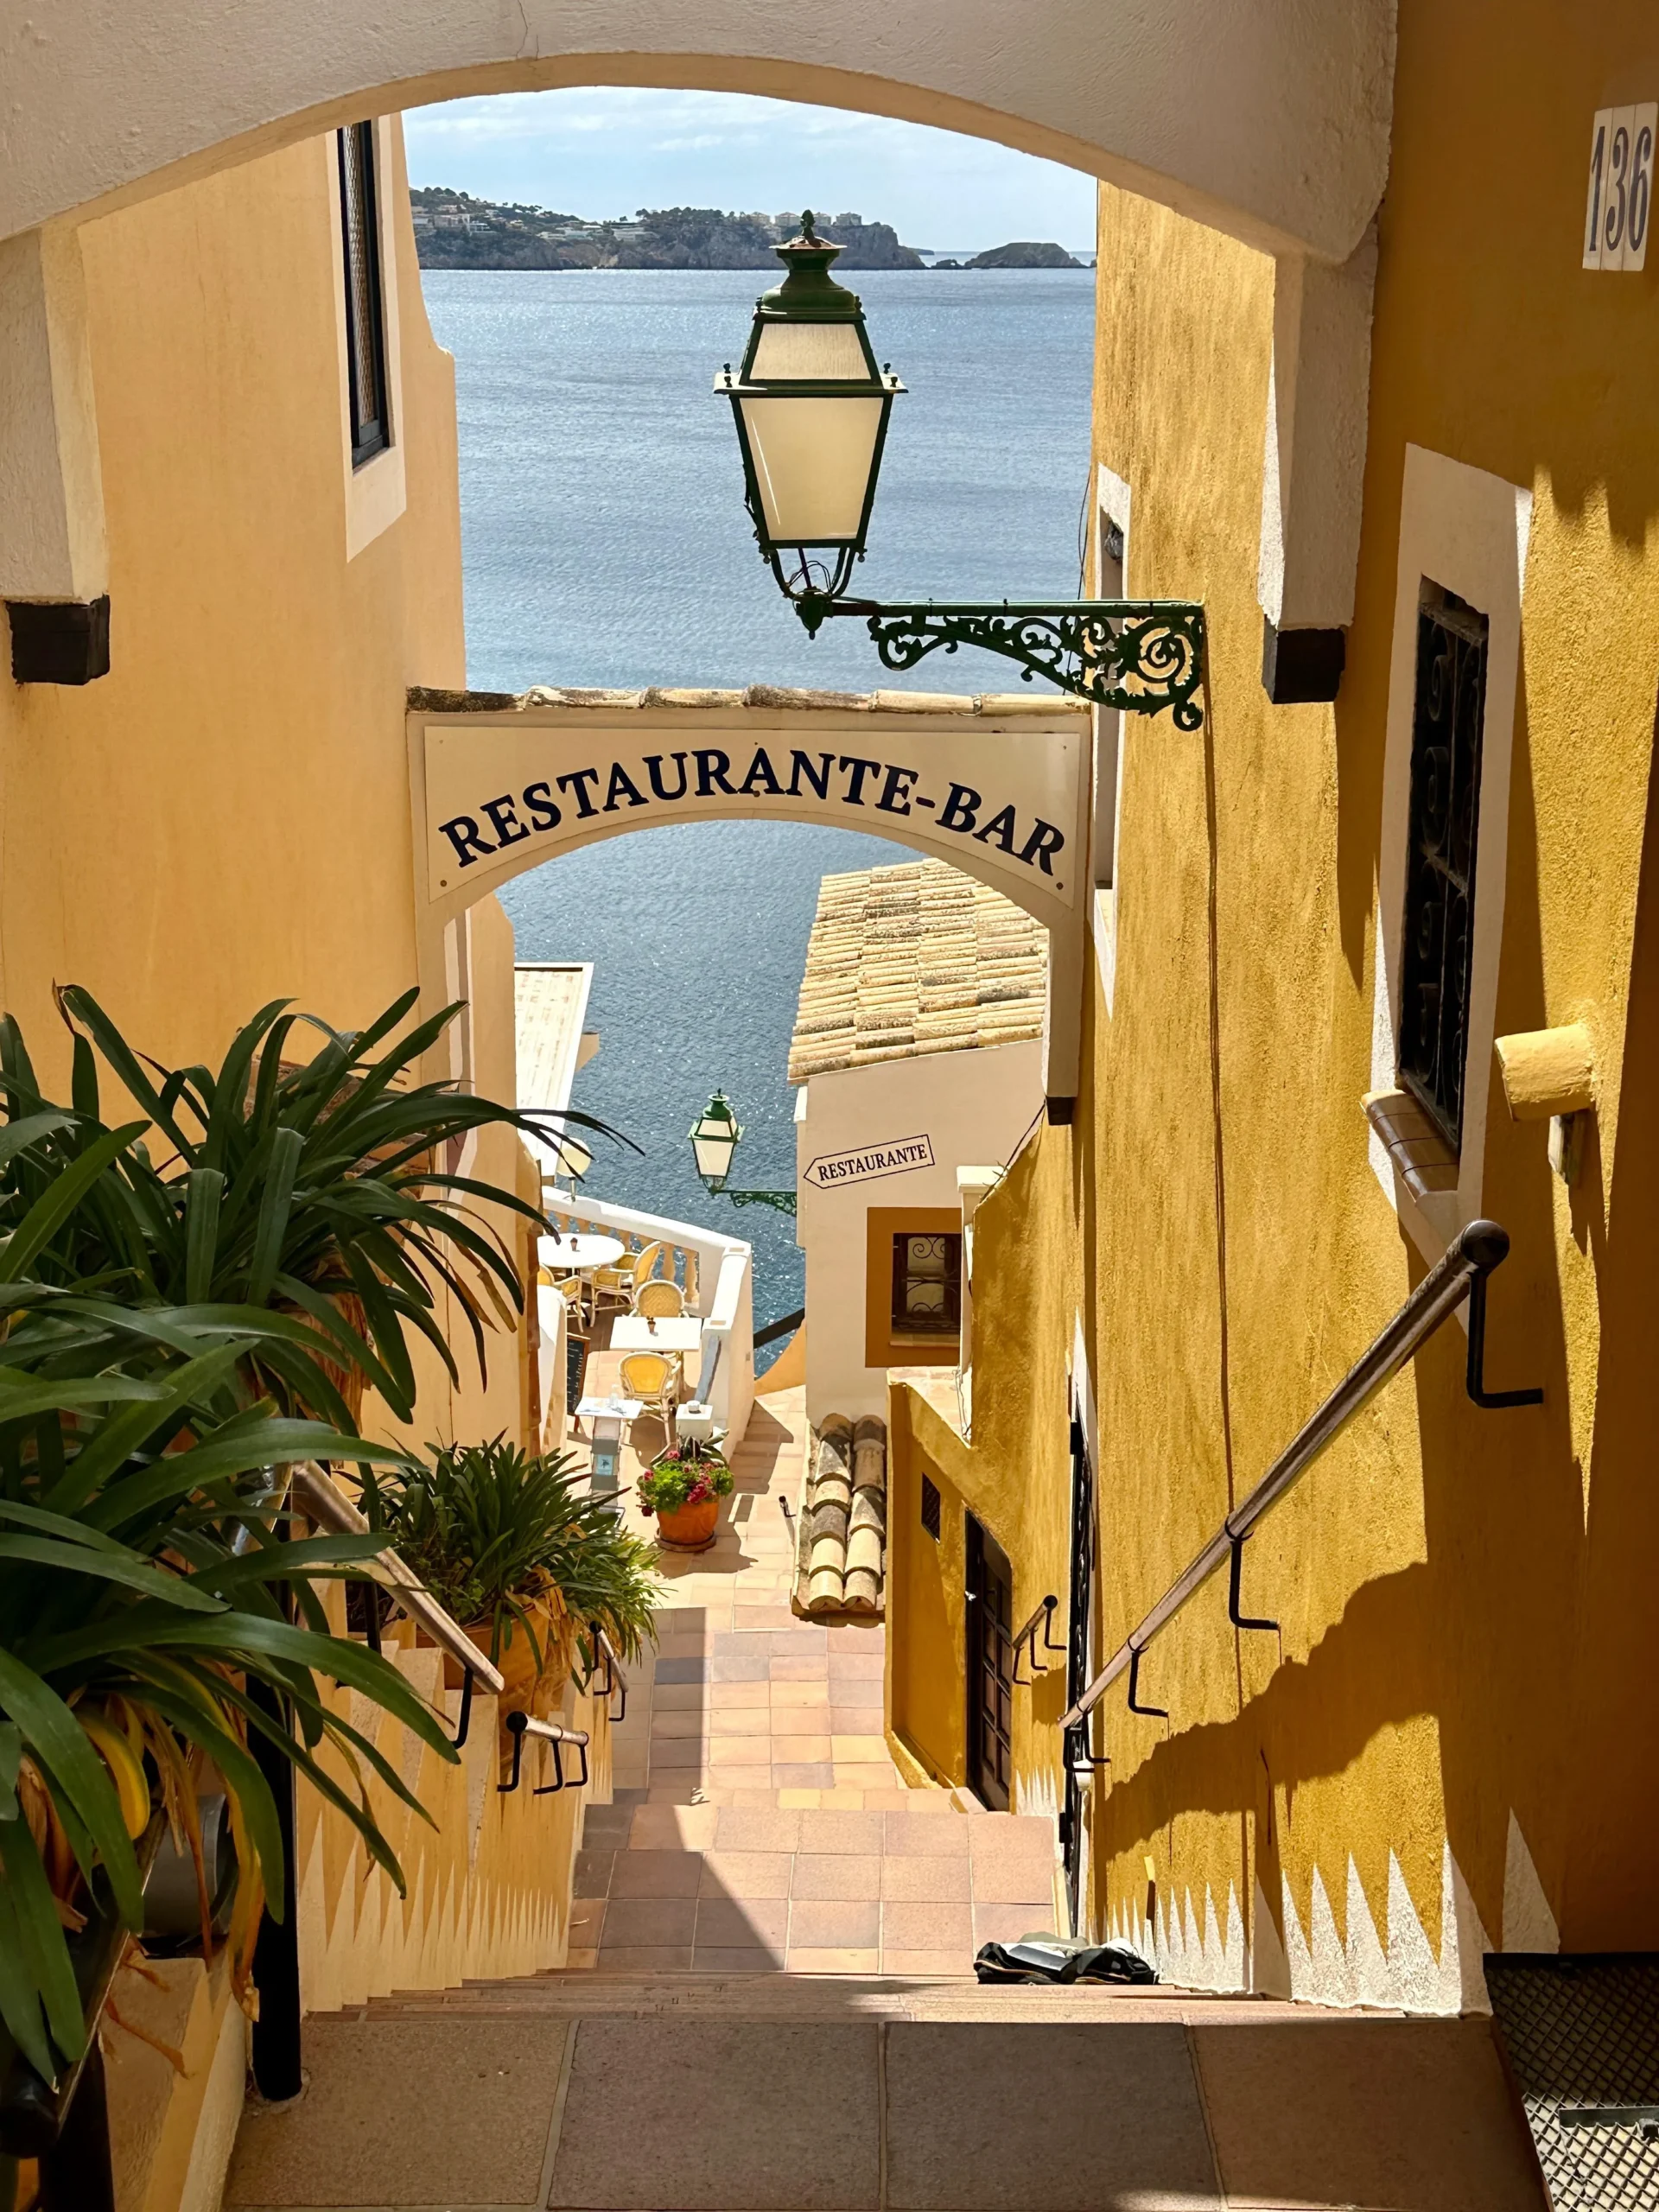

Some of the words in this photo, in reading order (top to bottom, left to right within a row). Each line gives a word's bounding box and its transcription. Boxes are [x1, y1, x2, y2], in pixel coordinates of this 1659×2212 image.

[1588, 125, 1652, 251] 136
[439, 747, 1065, 876] RESTAURANTE-BAR
[817, 1143, 928, 1181] RESTAURANTE
